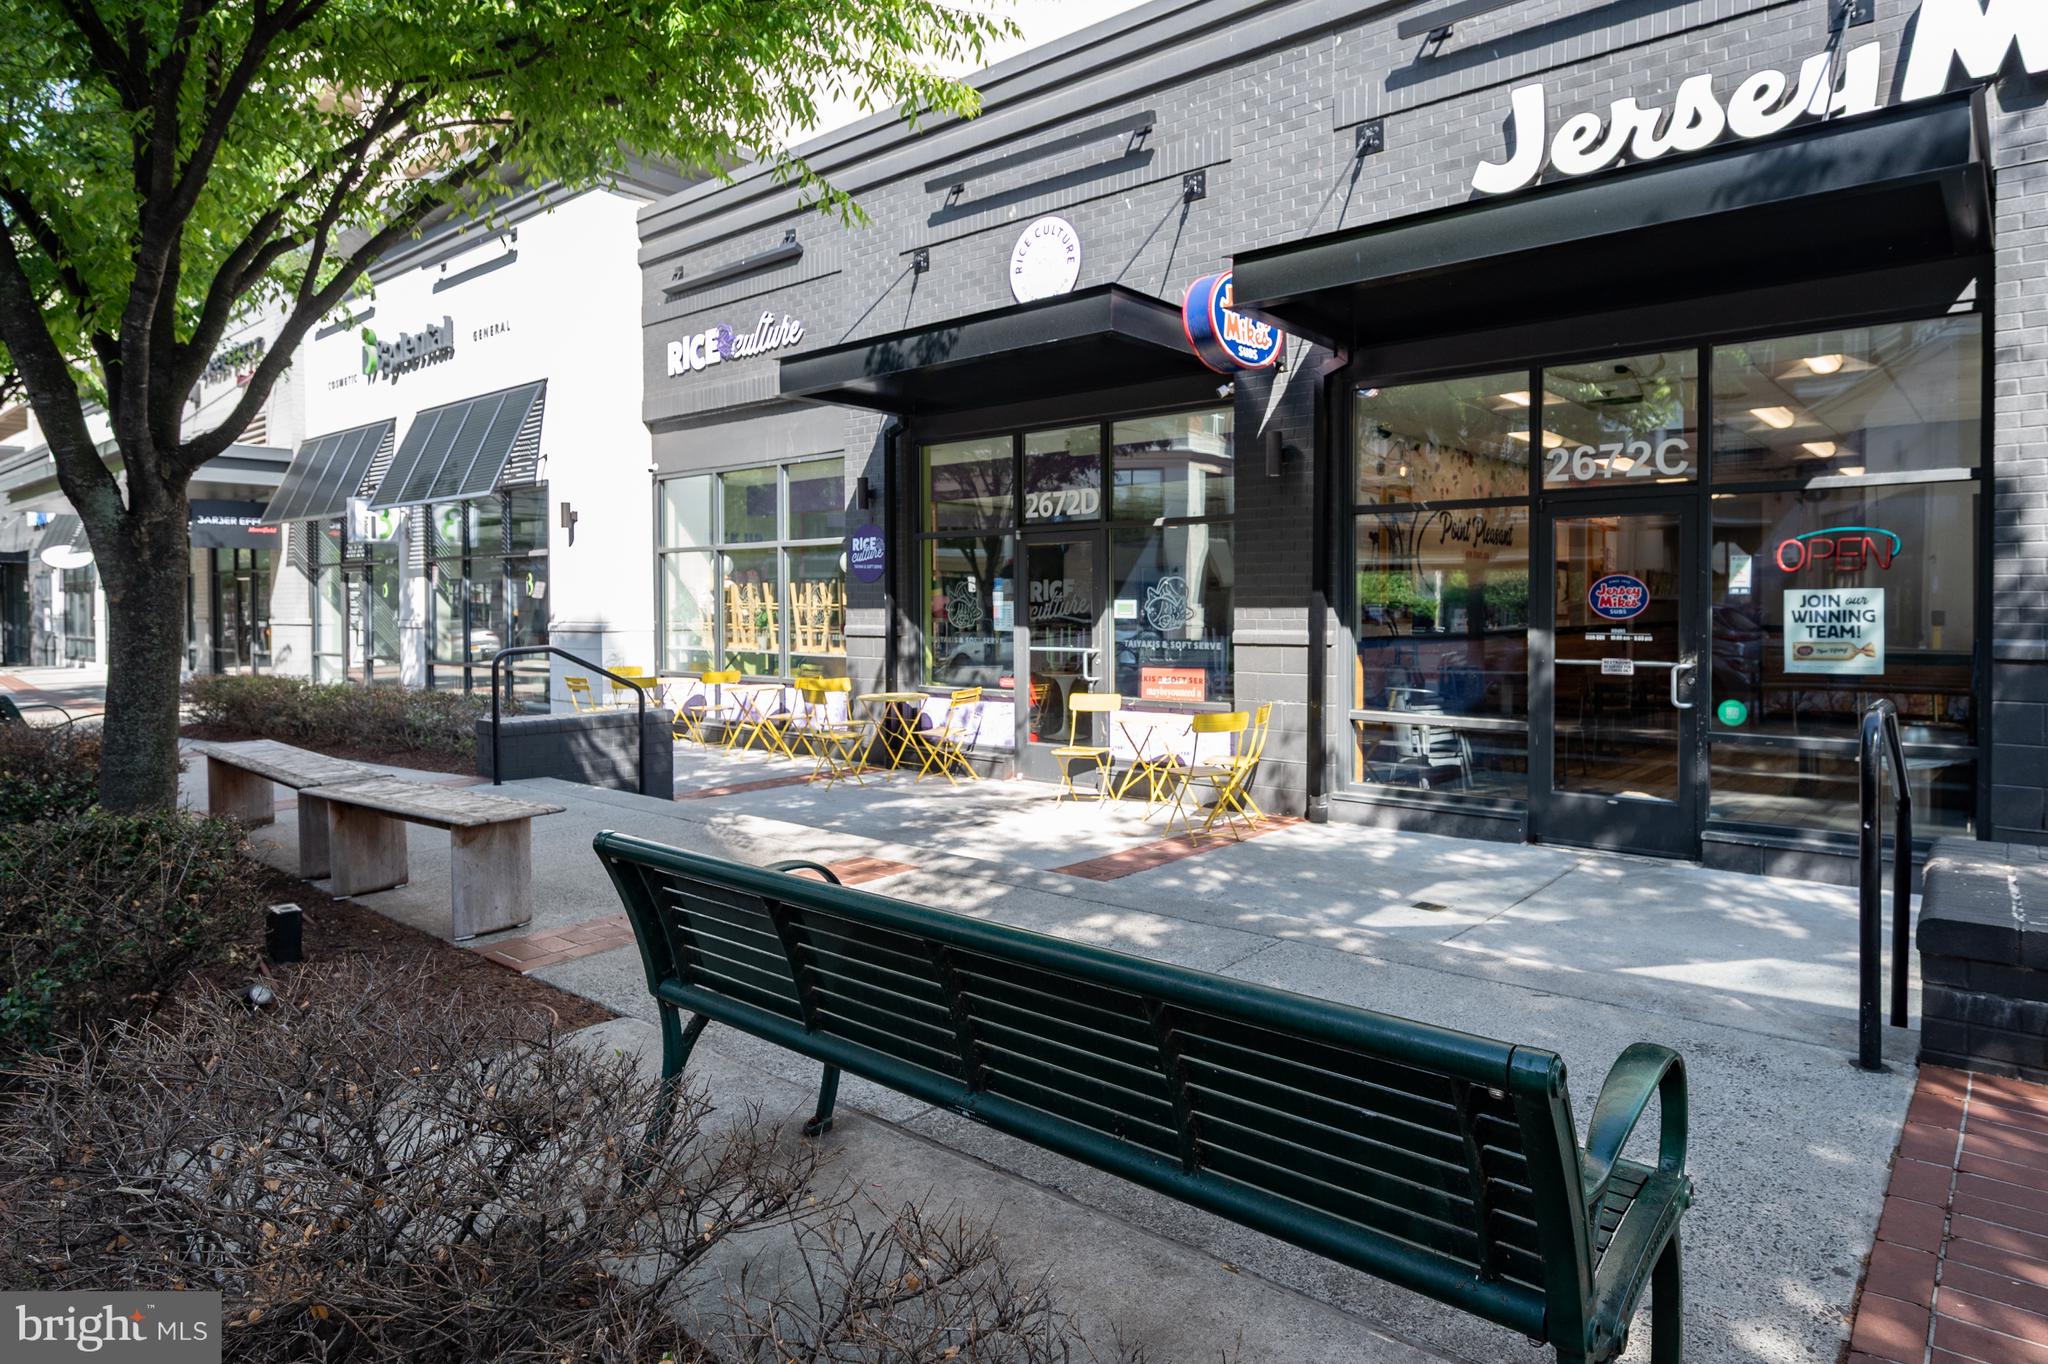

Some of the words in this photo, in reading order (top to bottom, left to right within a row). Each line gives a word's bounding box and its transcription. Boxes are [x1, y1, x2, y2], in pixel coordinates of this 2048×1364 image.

[1471, 41, 1881, 194] Jersey
[1015, 239, 1031, 274] RICE
[1035, 224, 1075, 264] CULTURE
[472, 320, 511, 342] GENERAL
[667, 327, 721, 377] RICE
[731, 310, 805, 359] culture
[1238, 345, 1259, 360] SUBS
[328, 374, 358, 391] COSMETIC
[1546, 438, 1690, 482] 2672C
[1025, 488, 1100, 519] 2672D
[1440, 511, 1472, 545] Point
[1472, 516, 1514, 548] Pleasant
[852, 536, 877, 552] RICE
[1776, 536, 1892, 573] OPEN
[851, 548, 885, 563] culture
[1029, 579, 1075, 602] RICE
[1595, 583, 1642, 598] Jersey
[1800, 595, 1840, 608] JOIN
[1845, 597, 1869, 605] our
[1029, 592, 1090, 621] culture
[1792, 610, 1876, 623] WINNING
[1806, 625, 1861, 639] TEAM!
[1124, 640, 1160, 650] TAIYAKIS
[1161, 641, 1169, 650] &
[1170, 641, 1192, 650] SOFT
[1193, 642, 1222, 650] SERVE
